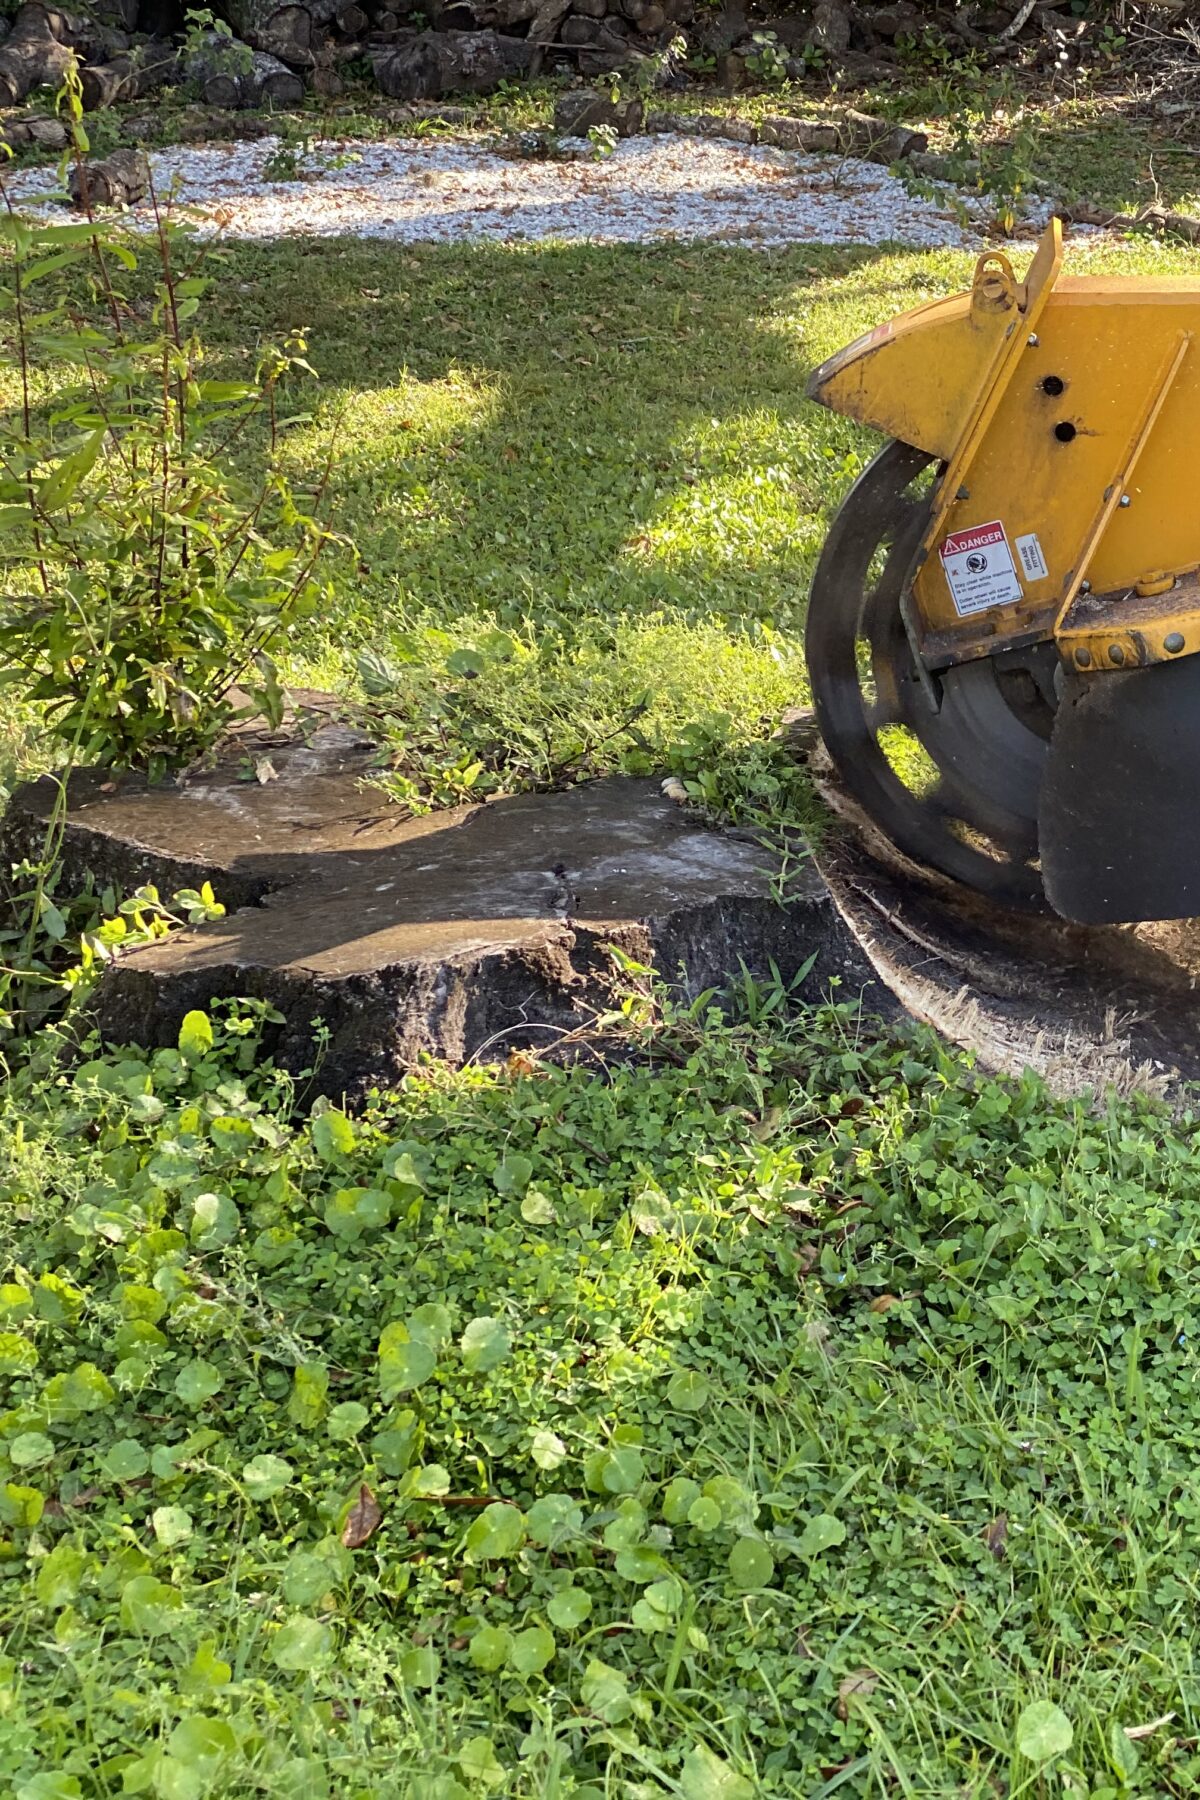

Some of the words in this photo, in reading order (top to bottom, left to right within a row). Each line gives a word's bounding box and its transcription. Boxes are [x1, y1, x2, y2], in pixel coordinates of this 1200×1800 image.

[959, 531, 1003, 551] DANGER
[1021, 546, 1033, 571] GREASE
[1027, 545, 1040, 568] FITTING
